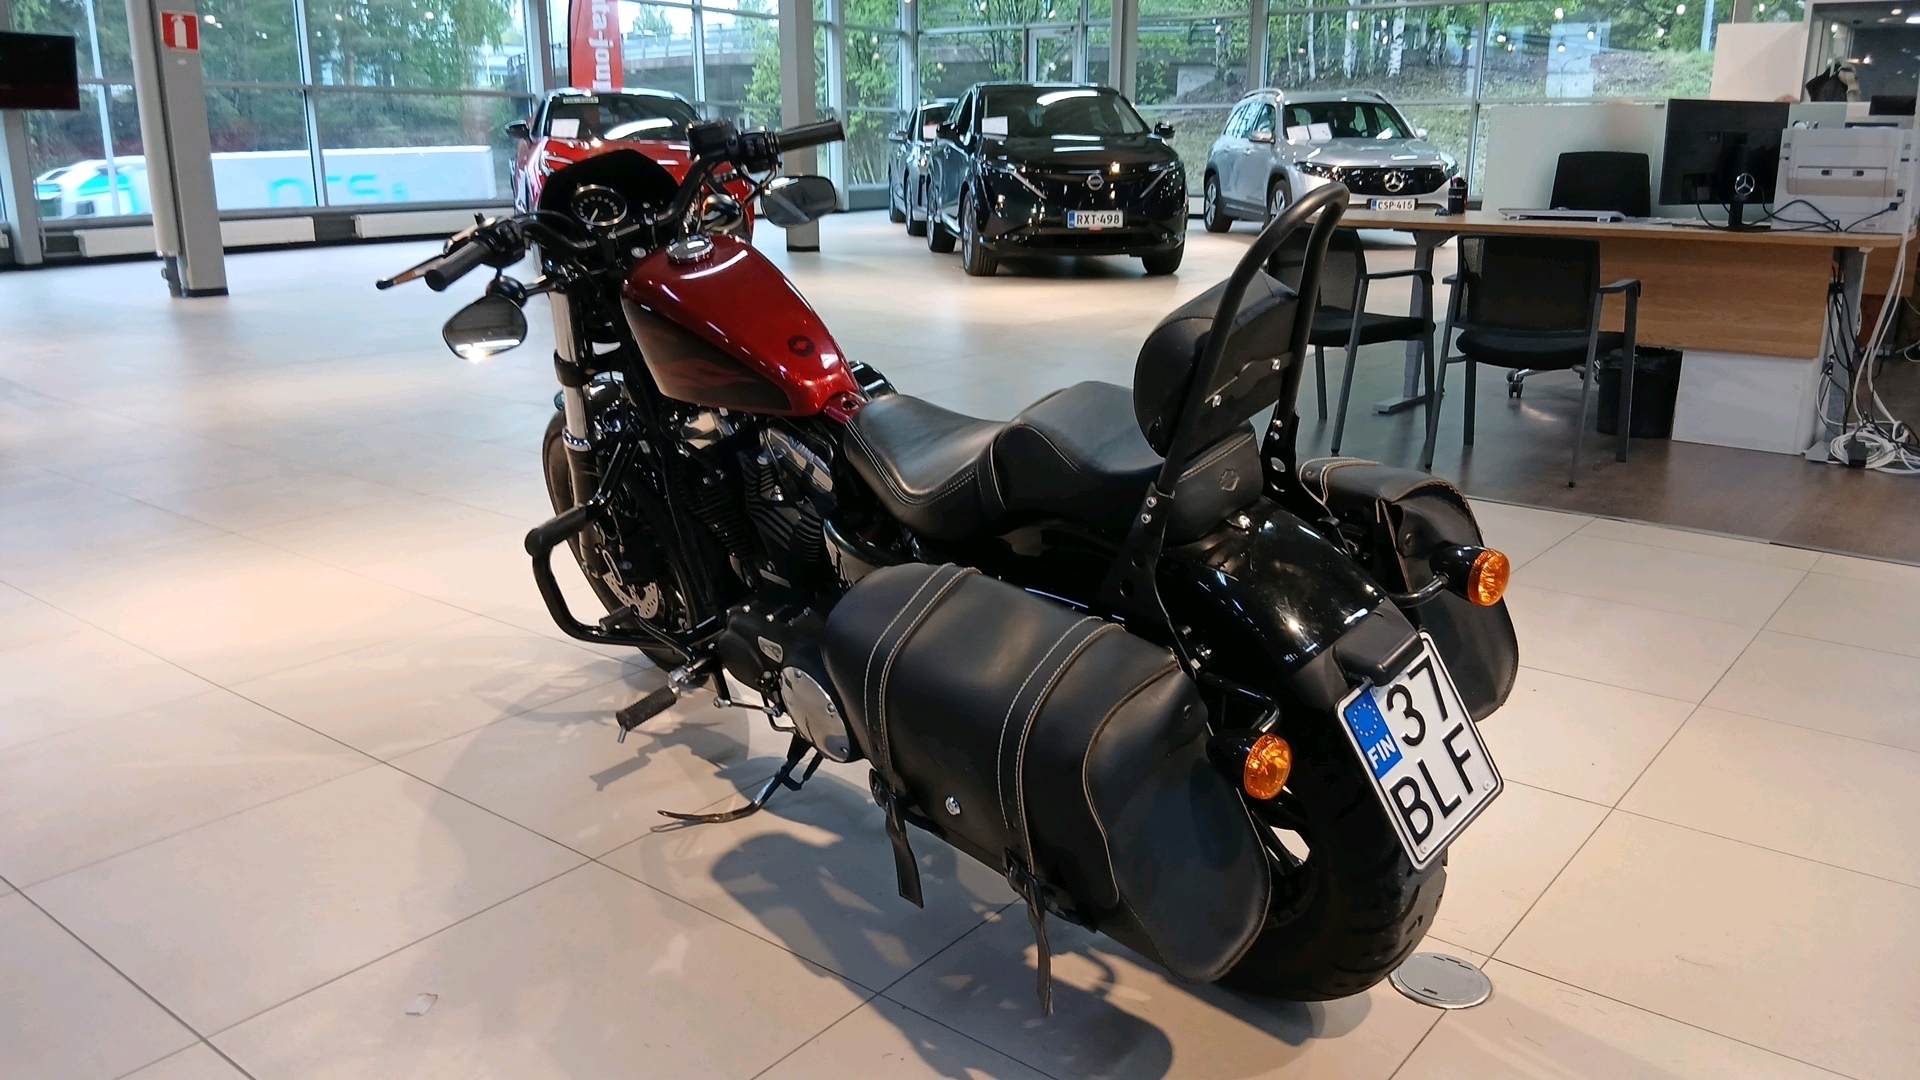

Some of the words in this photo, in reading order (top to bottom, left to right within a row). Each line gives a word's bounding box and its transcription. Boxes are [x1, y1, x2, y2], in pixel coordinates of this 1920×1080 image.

[1076, 214, 1120, 225] RXT-498
[1377, 200, 1413, 210] CSP-415
[1386, 655, 1449, 747] 37
[1366, 733, 1398, 770] FIN
[1389, 722, 1474, 847] BLF
